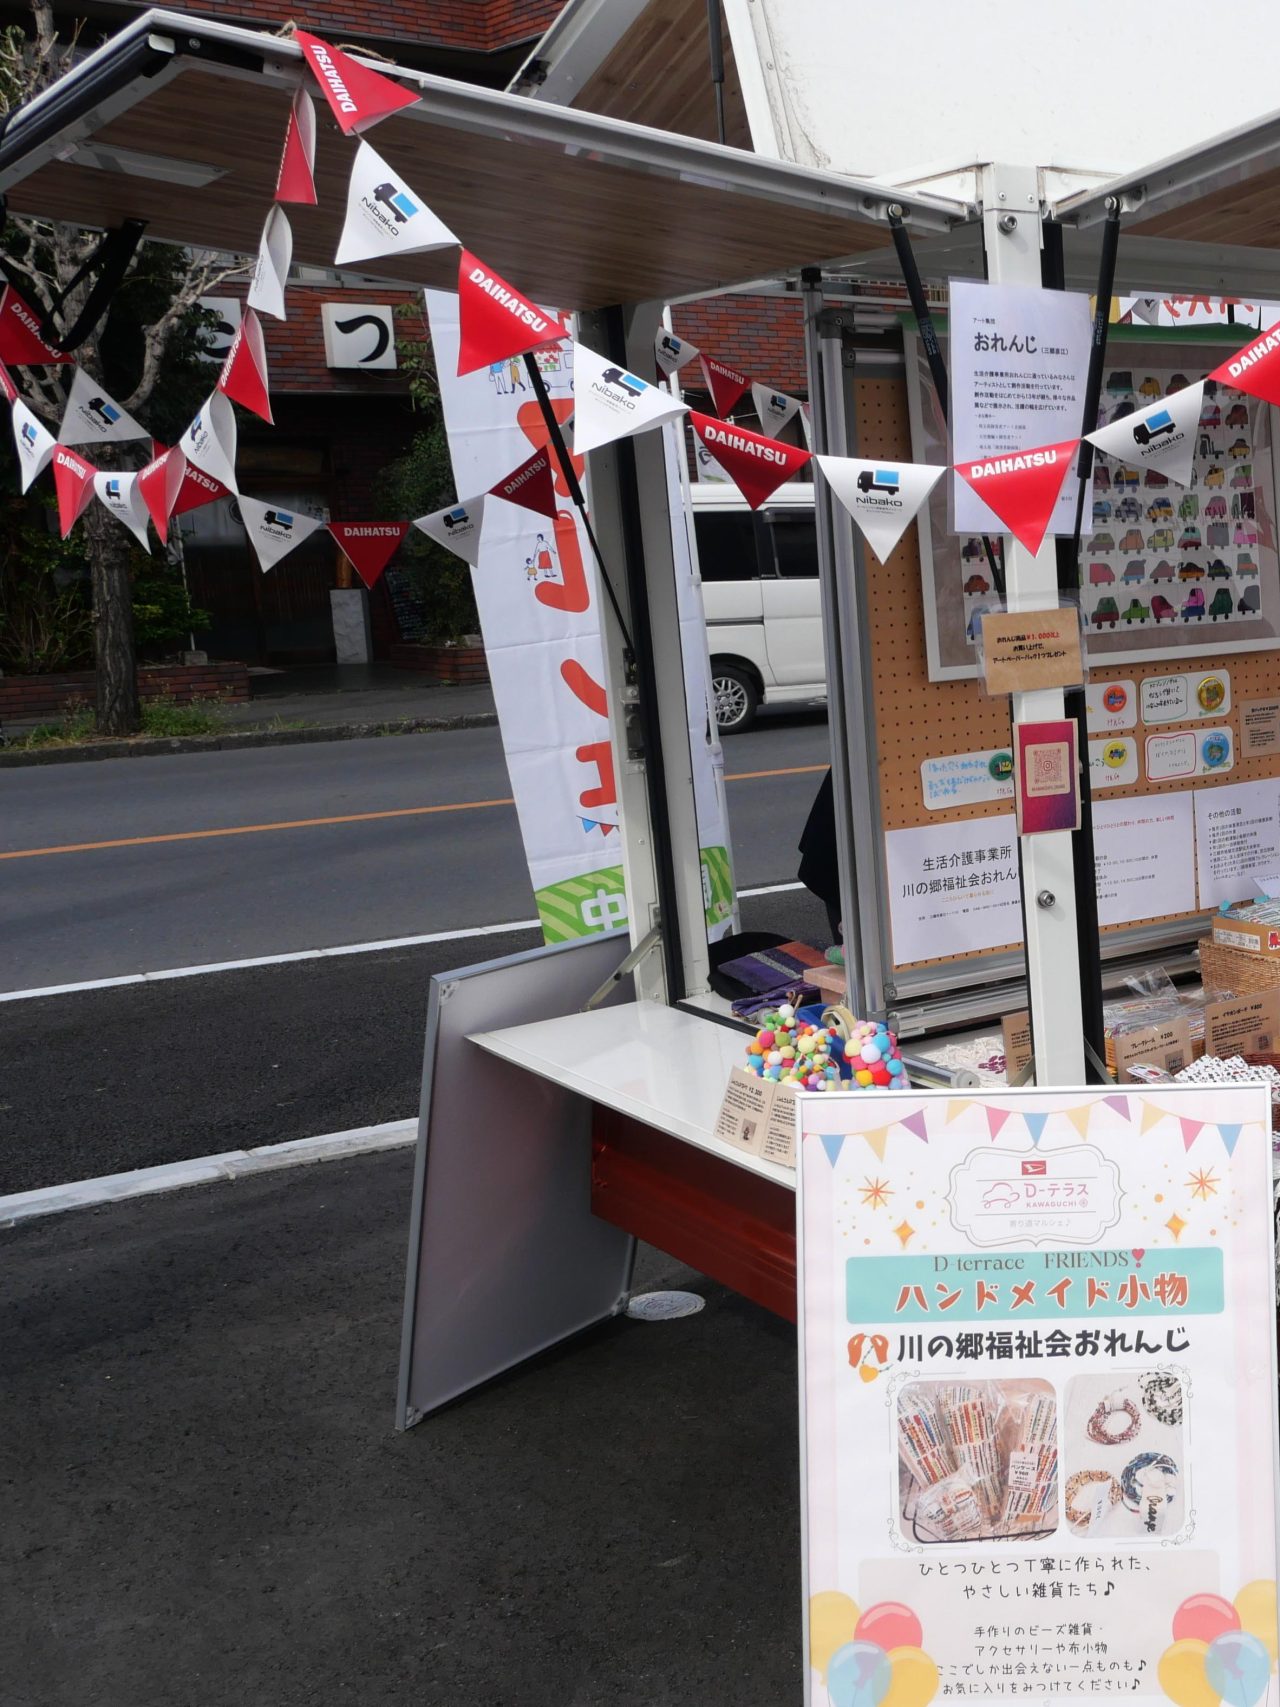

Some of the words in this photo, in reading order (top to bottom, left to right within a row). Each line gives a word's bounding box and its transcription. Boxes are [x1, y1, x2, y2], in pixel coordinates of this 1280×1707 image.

[311, 45, 358, 113] DAIHATSU
[361, 197, 400, 237] Nibako
[469, 268, 548, 333] DAIHATSU
[974, 332, 1037, 353] おれんじ
[710, 361, 744, 385] DAIHATSU
[591, 381, 637, 411] Nibako
[704, 424, 787, 466] DAIHATSU
[1141, 432, 1185, 457] Nibako
[503, 458, 547, 495] DAIHATSU
[971, 450, 1057, 479] DAIHATSU
[856, 495, 905, 507] Nibako
[260, 525, 293, 540] Nibako
[343, 527, 401, 537] DAIHATSU
[1207, 808, 1242, 820] その他の活動
[923, 845, 1012, 871] 生活介護事業所
[903, 868, 1019, 898] 川の郷福祉会おれん
[1025, 1182, 1089, 1198] D-テラス
[1026, 1200, 1077, 1208] KAWAGUCHI
[934, 1256, 1025, 1272] D-terrace
[895, 1272, 1189, 1313] ハンドメイド小物
[896, 1328, 1191, 1362] 川の郷福祉会おれんじ
[920, 1556, 1153, 1576] ひとつひとつ丁寧に作られた、
[974, 1641, 1109, 1657] アクセサリーや布小物
